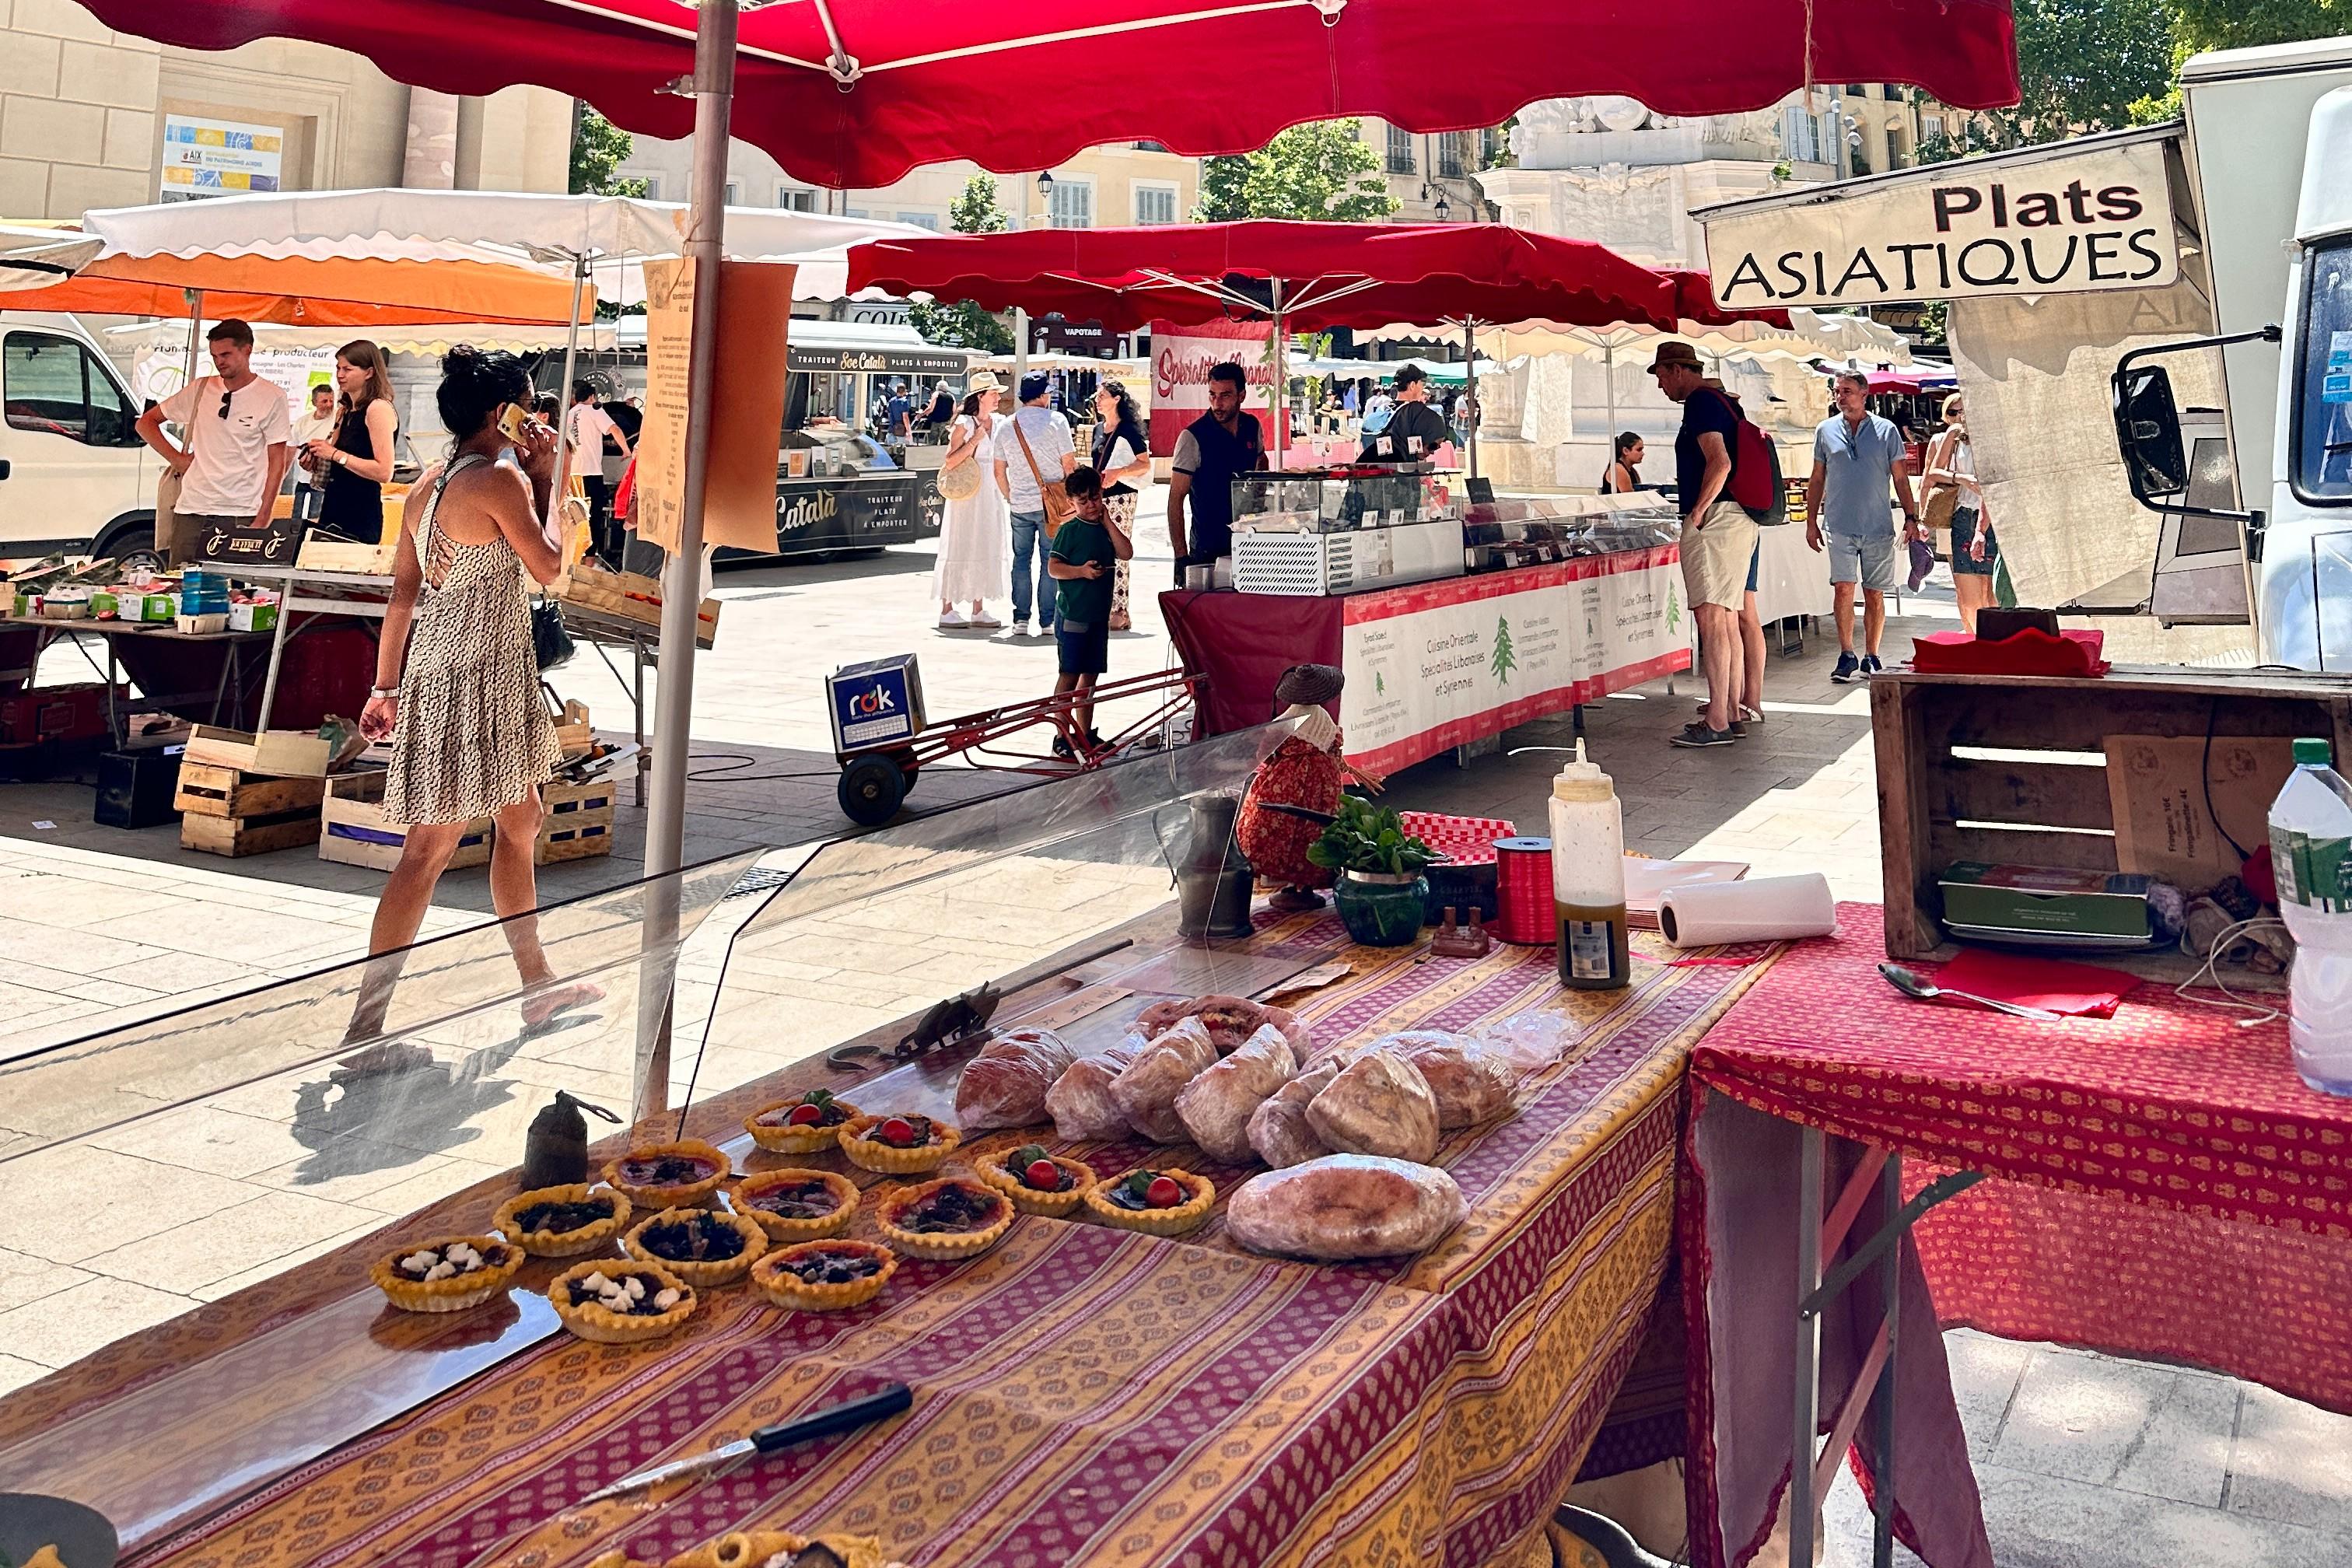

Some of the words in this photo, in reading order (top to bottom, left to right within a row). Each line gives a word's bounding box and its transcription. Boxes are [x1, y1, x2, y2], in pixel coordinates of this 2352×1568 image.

[189, 150, 202, 160] AIX
[1931, 179, 2144, 233] Plats
[1720, 229, 2164, 303] ASIATIQUES
[1064, 327, 1103, 337] VAPOTAGE
[272, 348, 330, 359] producteur
[797, 355, 836, 365] TRAITEUR
[858, 352, 887, 370] Català
[867, 495, 903, 504] TRAITEUR
[775, 488, 838, 534] Català
[871, 520, 908, 528] EMPORTER
[1426, 638, 1450, 654] Cuisine
[1450, 630, 1479, 649] Orientale
[1421, 659, 1453, 681] Spécialités
[1453, 651, 1486, 670] Libanaises
[1435, 684, 1443, 697] et
[849, 684, 894, 716] rok
